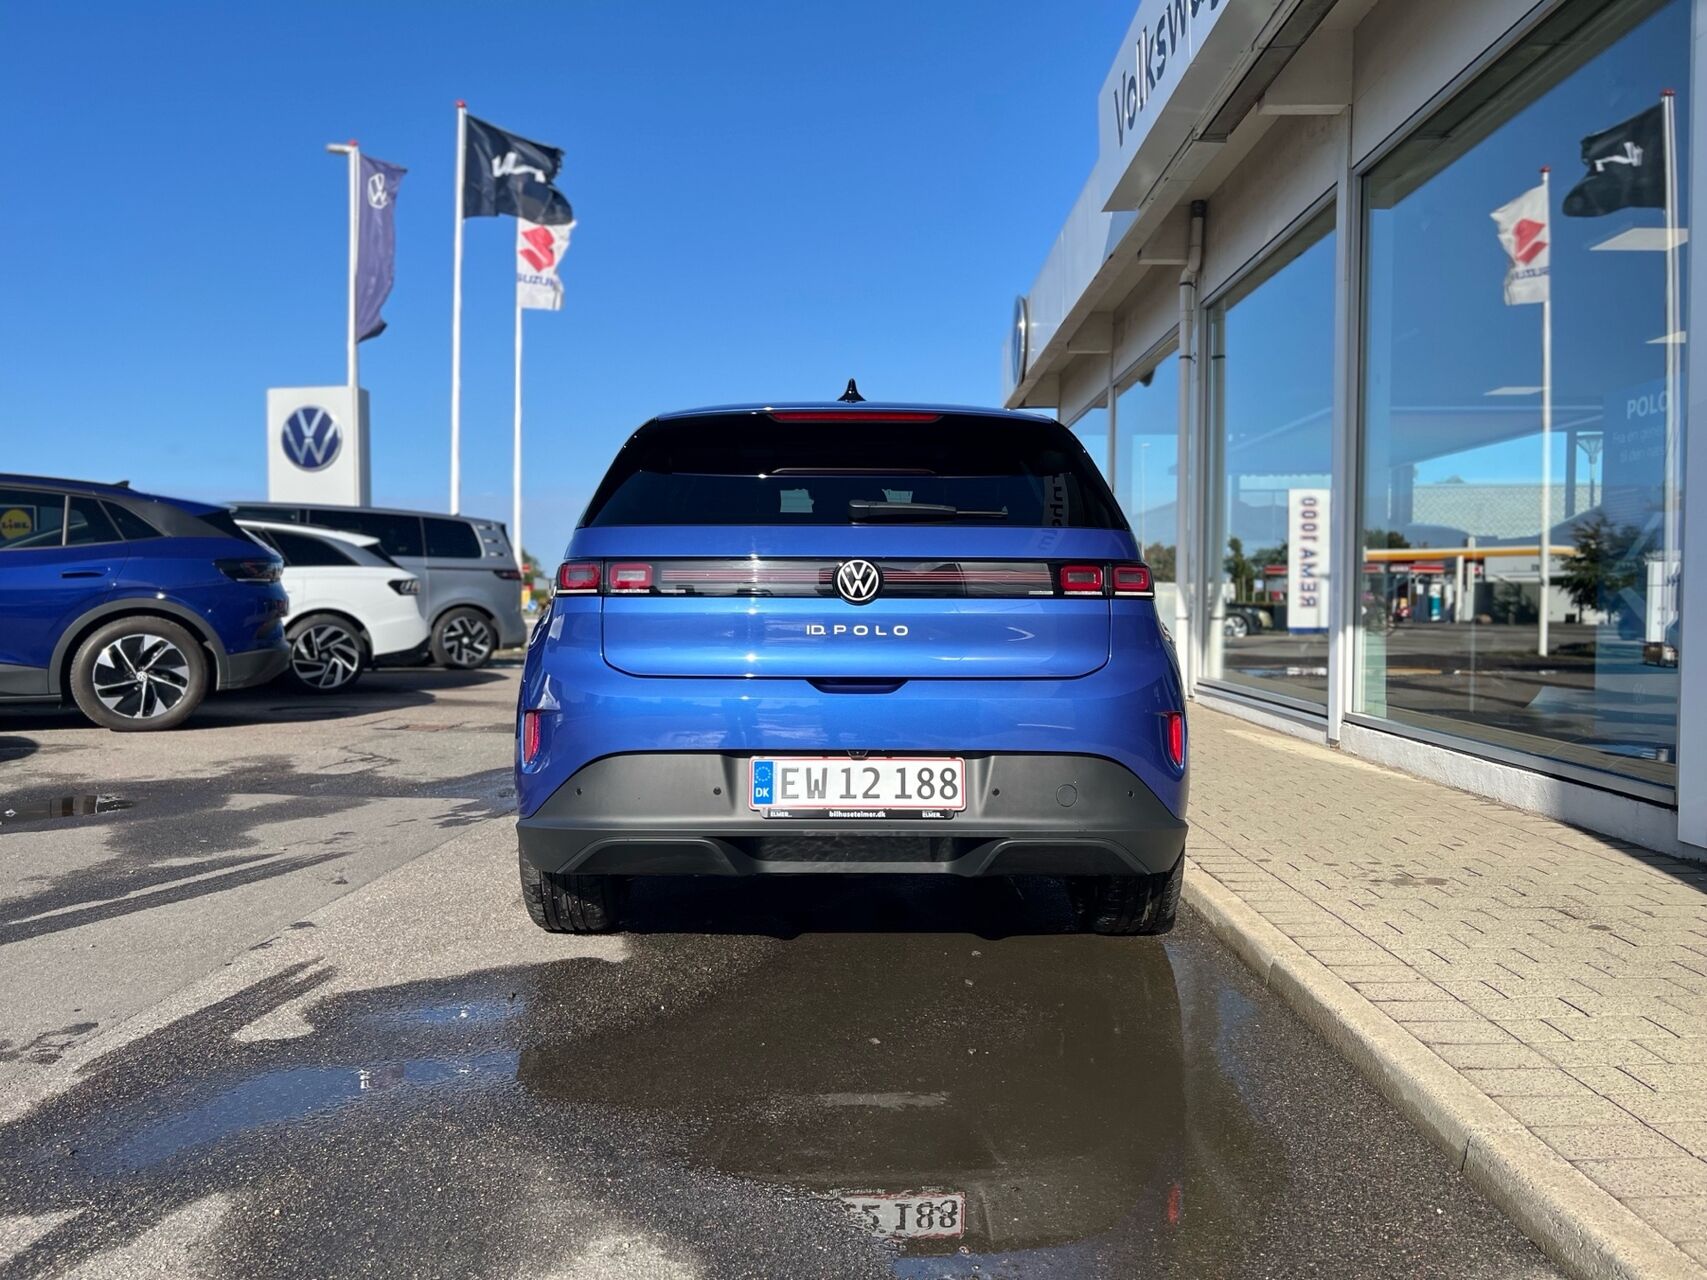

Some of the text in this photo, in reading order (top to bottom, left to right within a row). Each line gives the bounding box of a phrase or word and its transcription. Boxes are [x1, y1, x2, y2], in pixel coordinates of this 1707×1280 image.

[833, 624, 909, 636] POLO
[781, 767, 958, 800] EW 12 188
[755, 787, 769, 798] DK
